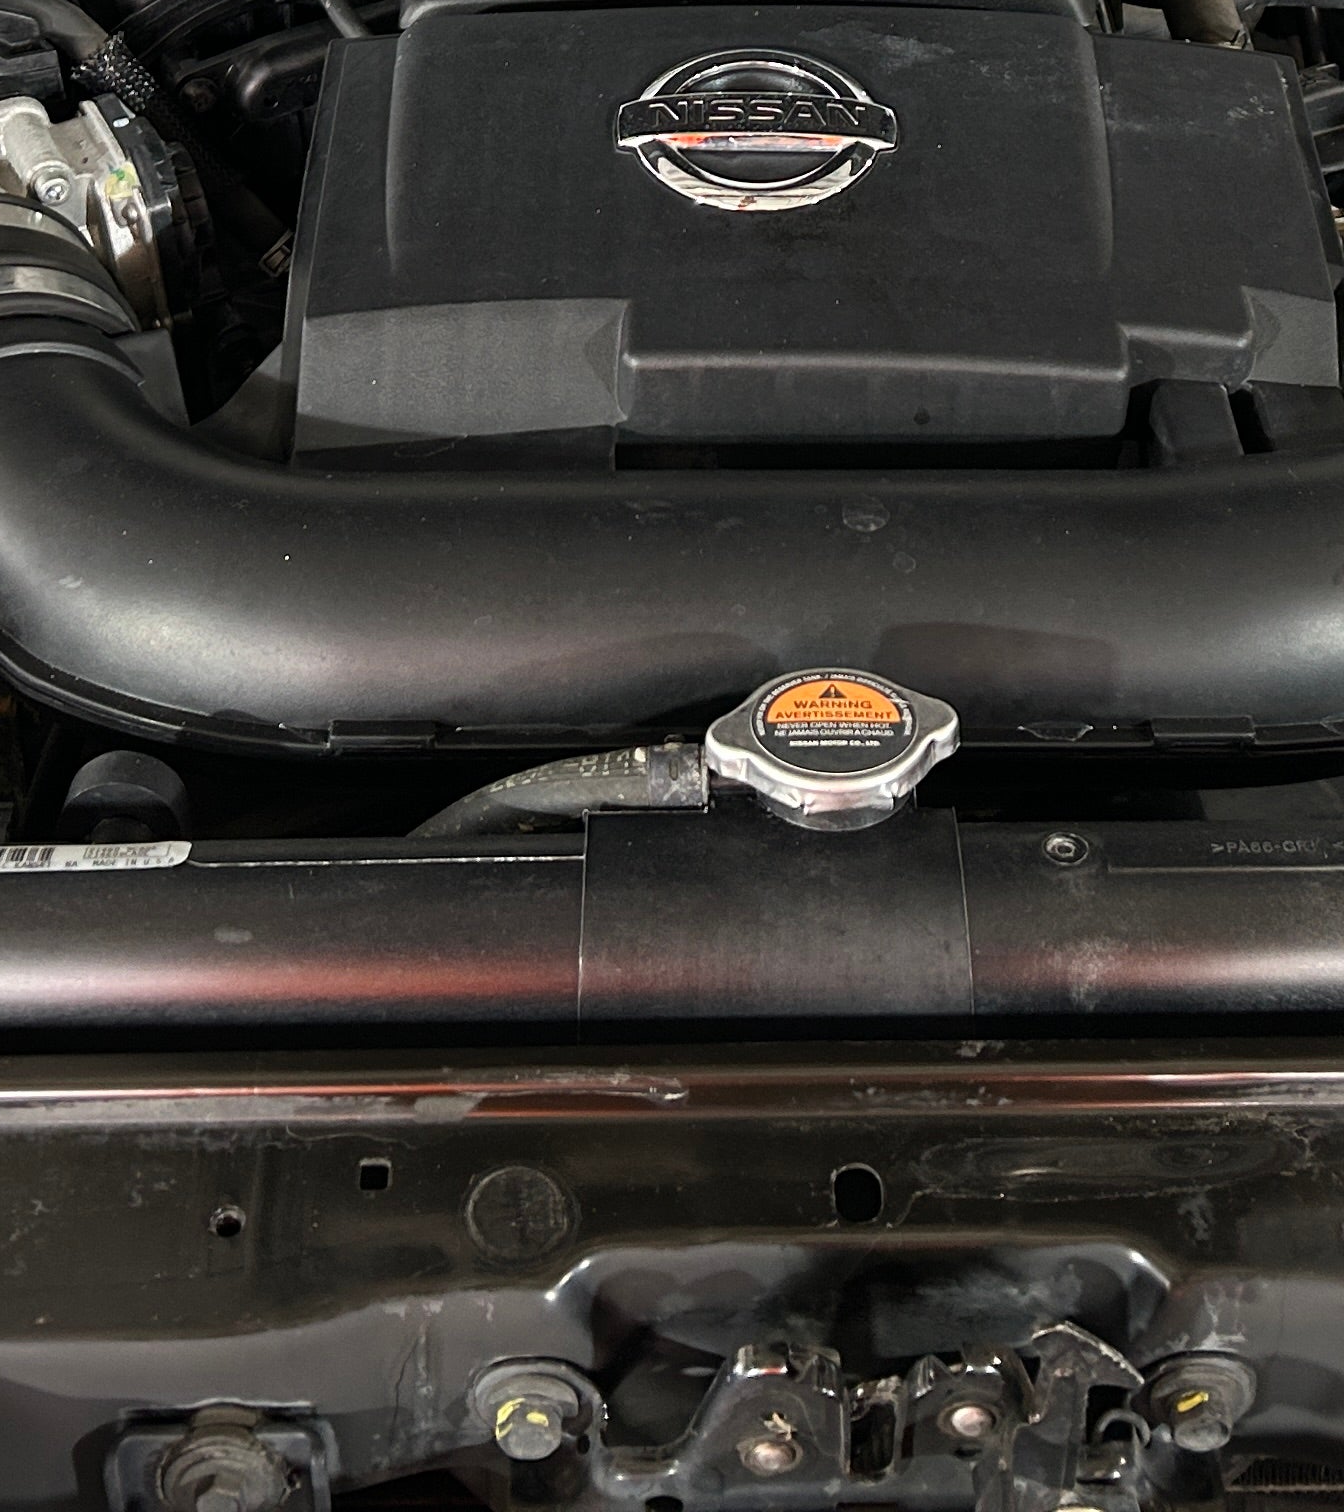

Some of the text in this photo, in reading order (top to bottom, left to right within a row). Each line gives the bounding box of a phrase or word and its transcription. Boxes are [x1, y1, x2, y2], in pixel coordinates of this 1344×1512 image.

[649, 99, 866, 126] NISSAN
[793, 700, 873, 709] WARNING
[775, 710, 893, 719] AVERTISSEMENT
[789, 739, 819, 747] NISSAN
[820, 739, 848, 747] MOTOR
